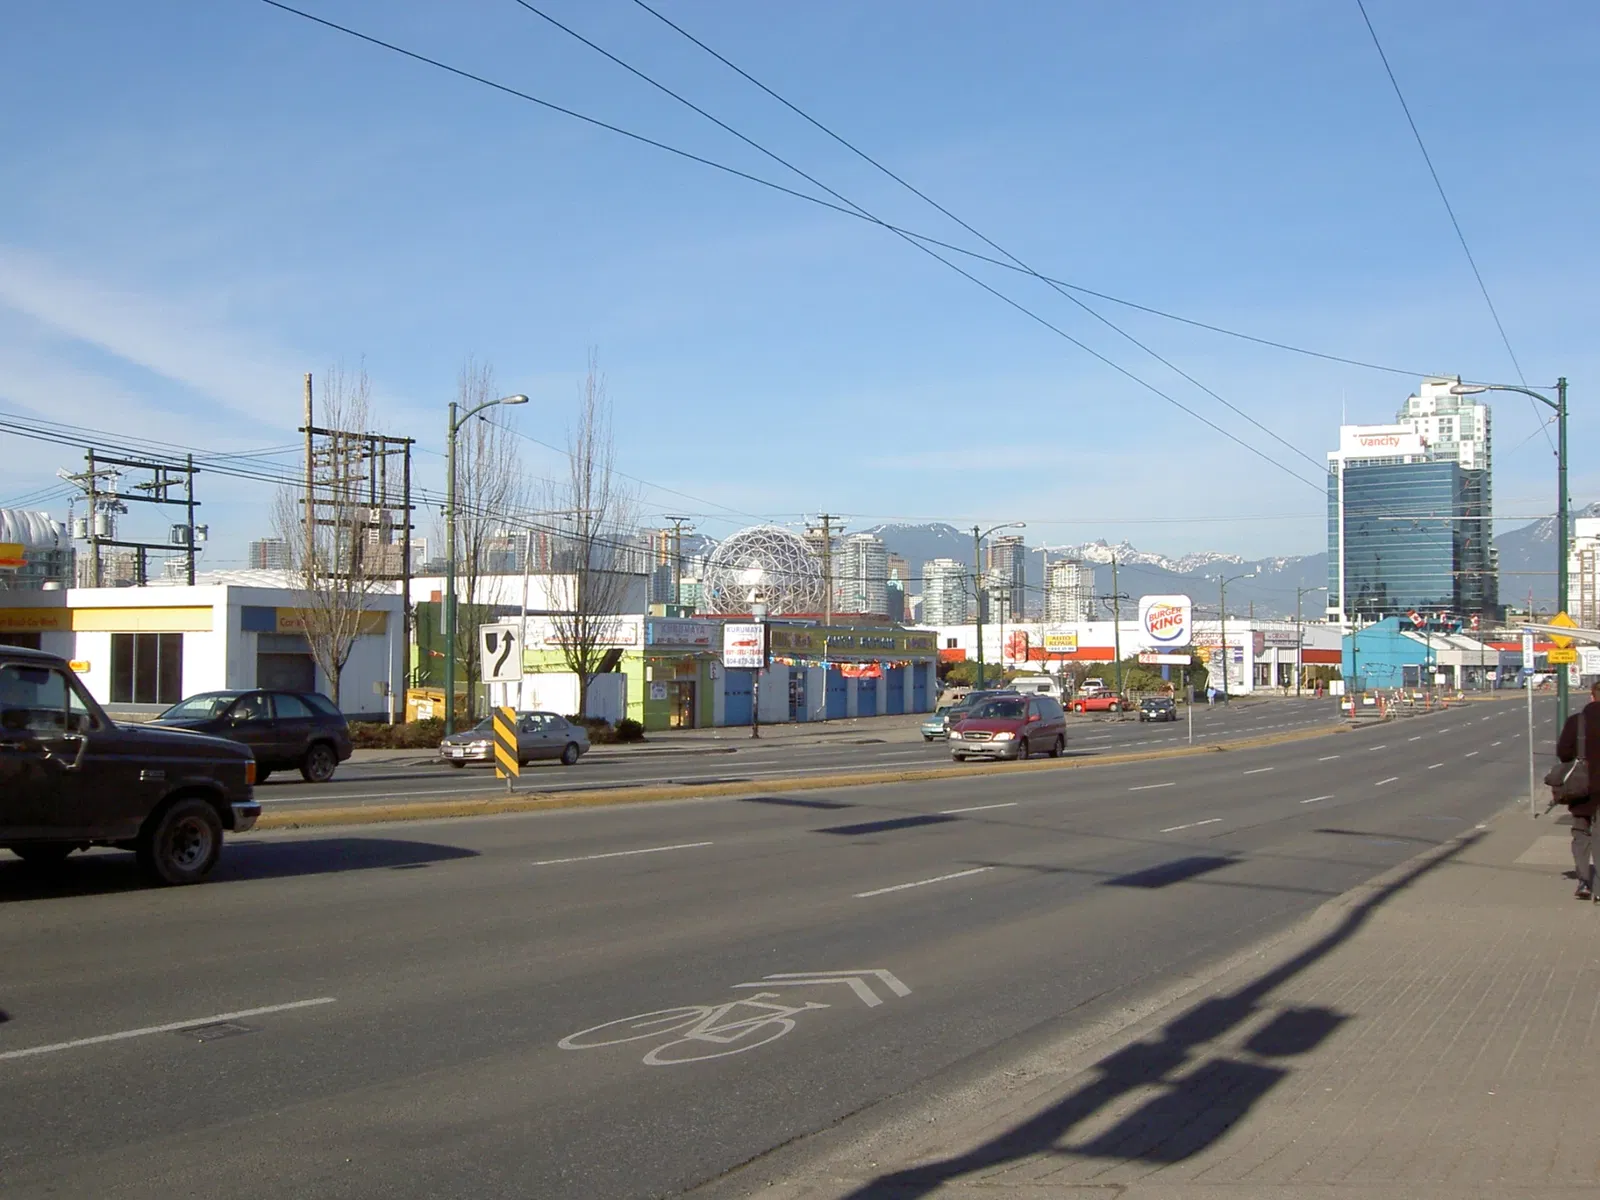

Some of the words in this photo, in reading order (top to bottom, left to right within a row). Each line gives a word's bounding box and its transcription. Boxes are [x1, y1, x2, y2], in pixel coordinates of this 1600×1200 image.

[1360, 436, 1400, 447] Vancity
[1149, 606, 1182, 622] BURGER
[1150, 614, 1183, 632] KING
[1140, 654, 1150, 663] 24
